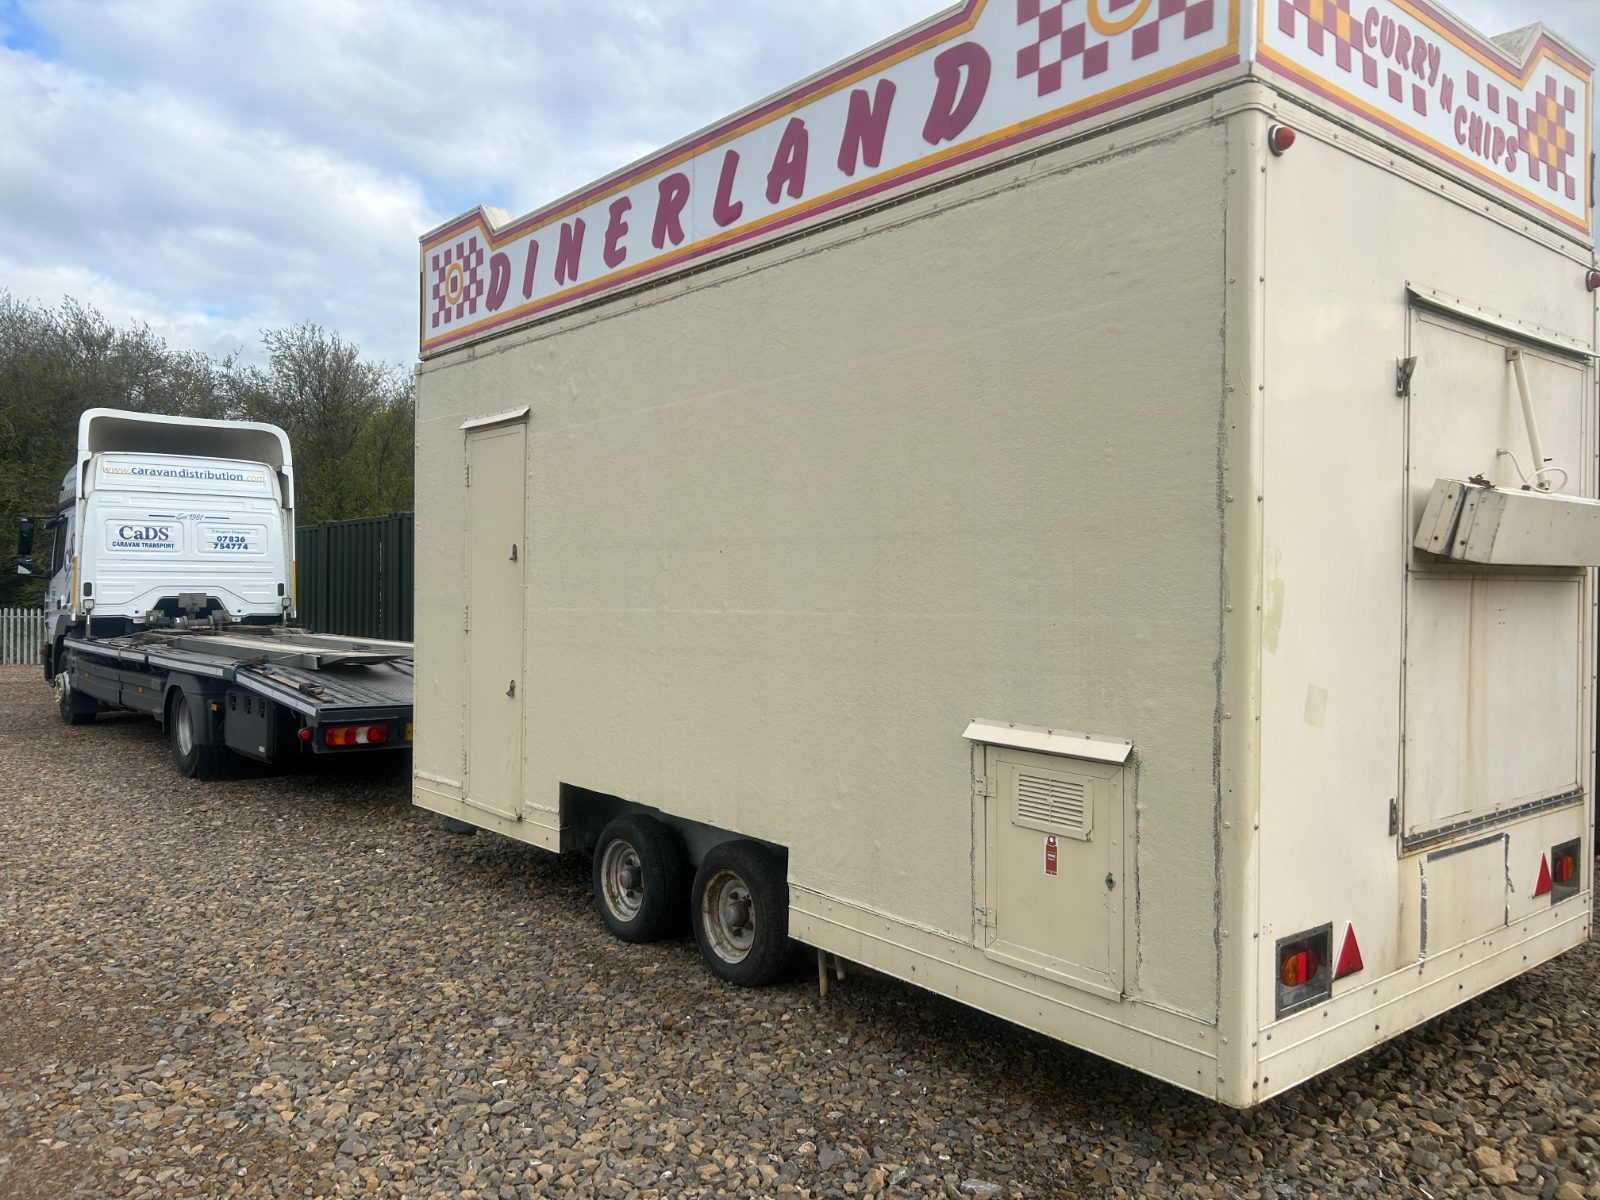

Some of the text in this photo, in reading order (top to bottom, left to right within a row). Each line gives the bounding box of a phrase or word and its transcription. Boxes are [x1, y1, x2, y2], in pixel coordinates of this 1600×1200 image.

[1364, 7, 1441, 87] CURRY
[1454, 105, 1519, 172] CHIPS
[486, 41, 993, 312] DINERLAND
[103, 466, 265, 483] www.caravandistribution.com
[119, 525, 169, 541] CaDS
[216, 535, 246, 543] 07836
